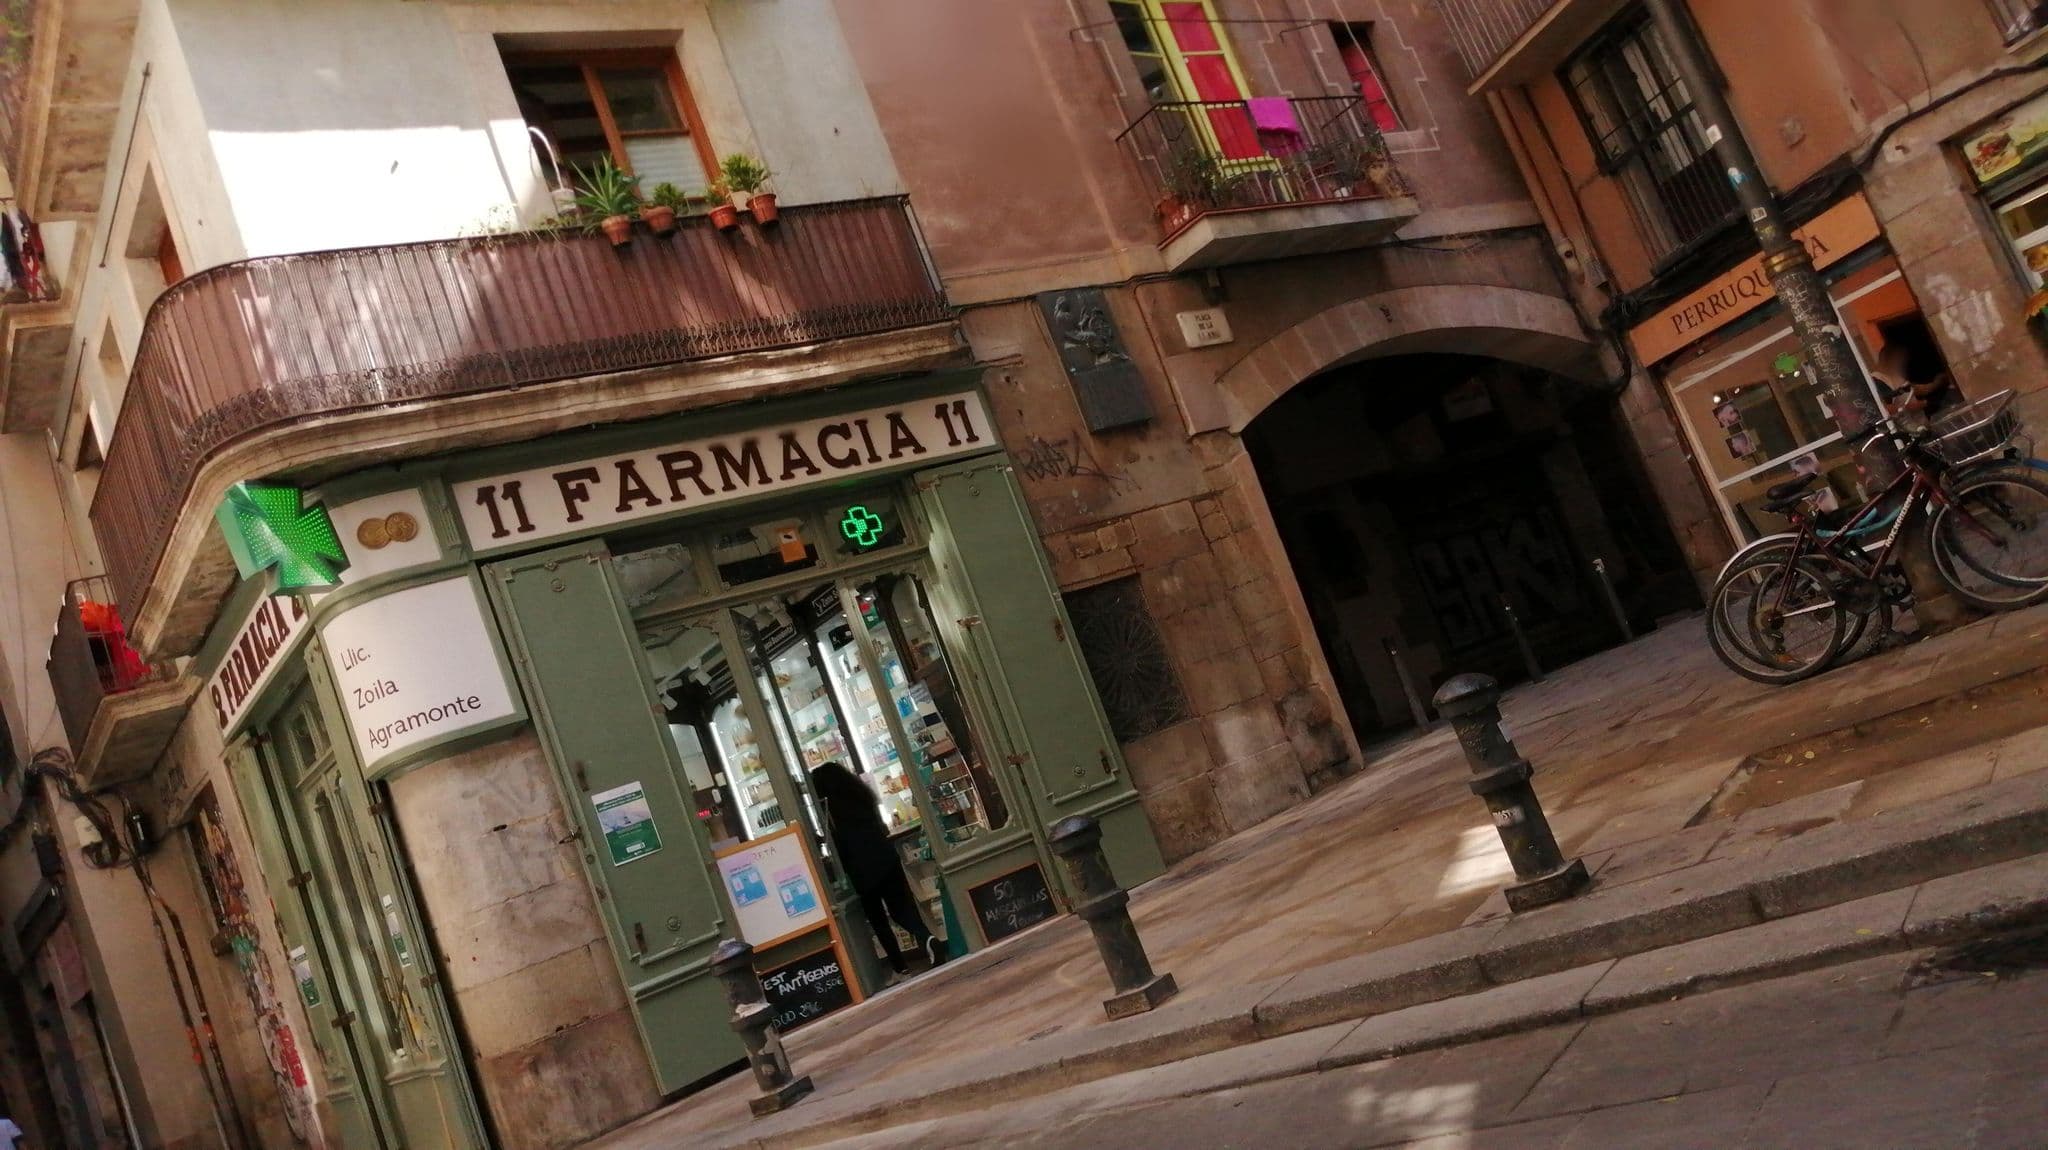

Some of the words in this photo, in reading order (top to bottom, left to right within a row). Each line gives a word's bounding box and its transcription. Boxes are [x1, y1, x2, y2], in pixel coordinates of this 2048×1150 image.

[1671, 236, 1830, 335] PERRUQUA
[476, 480, 536, 539] 11
[553, 411, 926, 524] FARMACIA
[935, 400, 980, 447] 11
[219, 595, 291, 716] FARMACIA
[340, 645, 371, 670] Llic.
[353, 677, 399, 710] Zoila
[368, 694, 482, 748] Agramonte
[759, 971, 786, 990] EST
